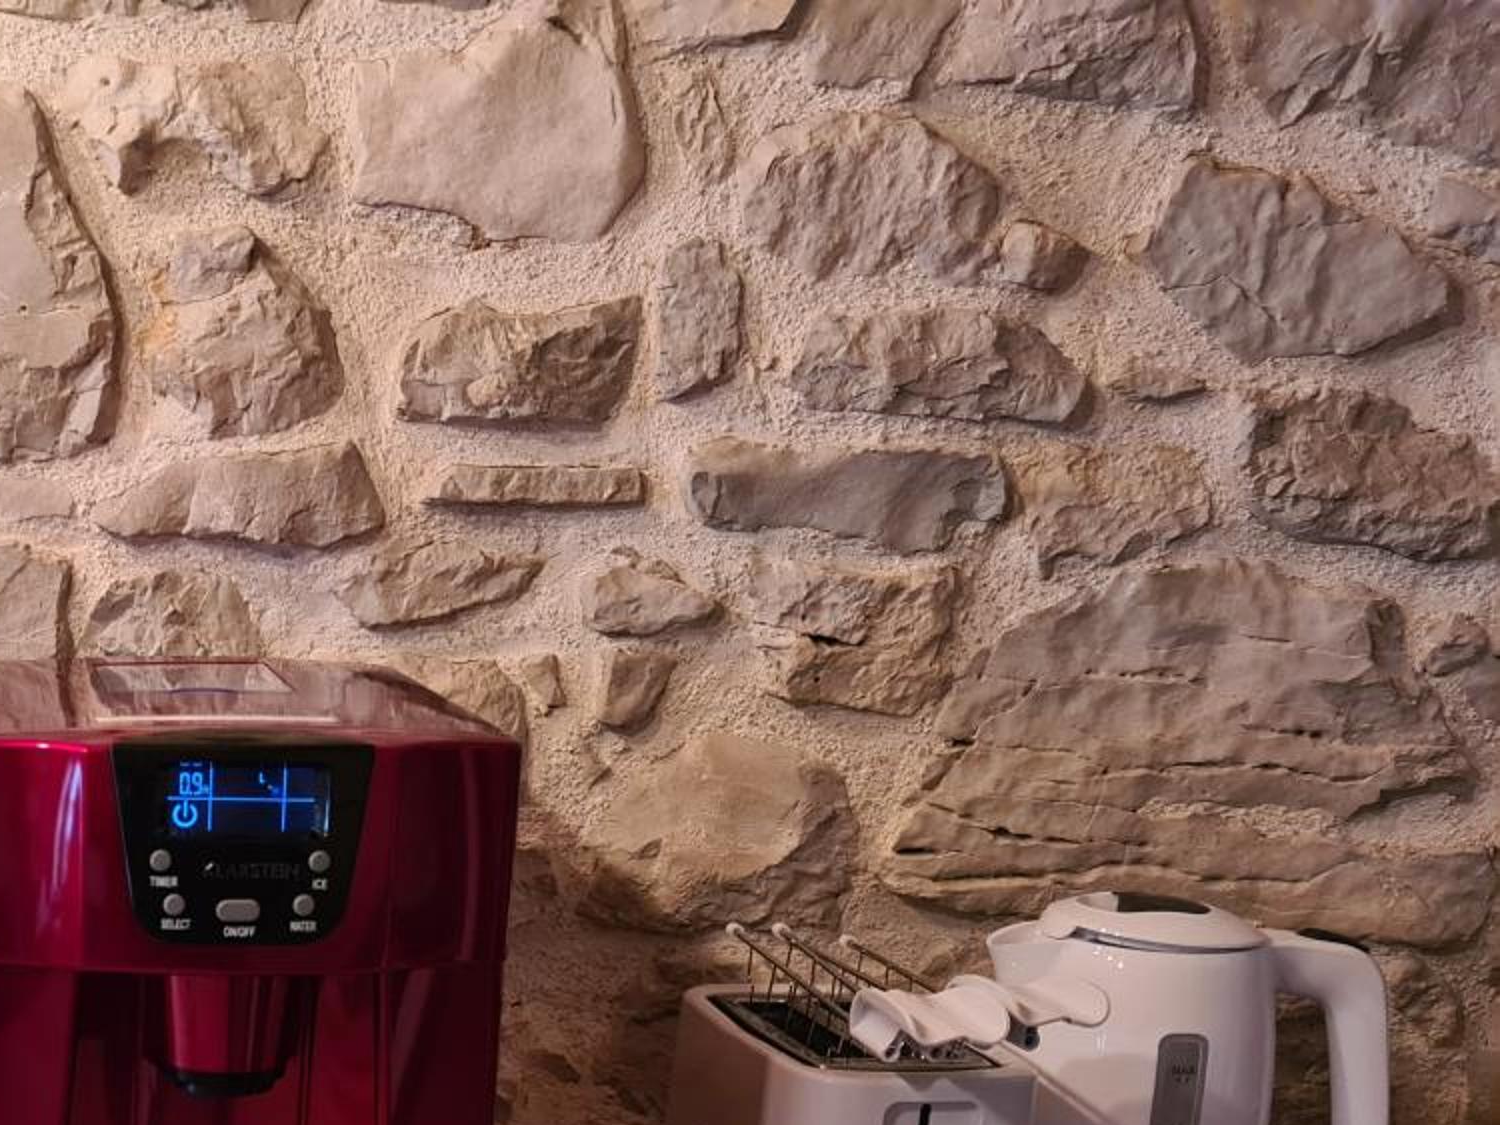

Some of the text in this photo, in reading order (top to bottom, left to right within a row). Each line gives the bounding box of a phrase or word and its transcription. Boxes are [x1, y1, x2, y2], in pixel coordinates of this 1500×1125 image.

[312, 879, 328, 891] ICE
[160, 918, 191, 930] SELECT
[223, 925, 256, 938] ON/OFF
